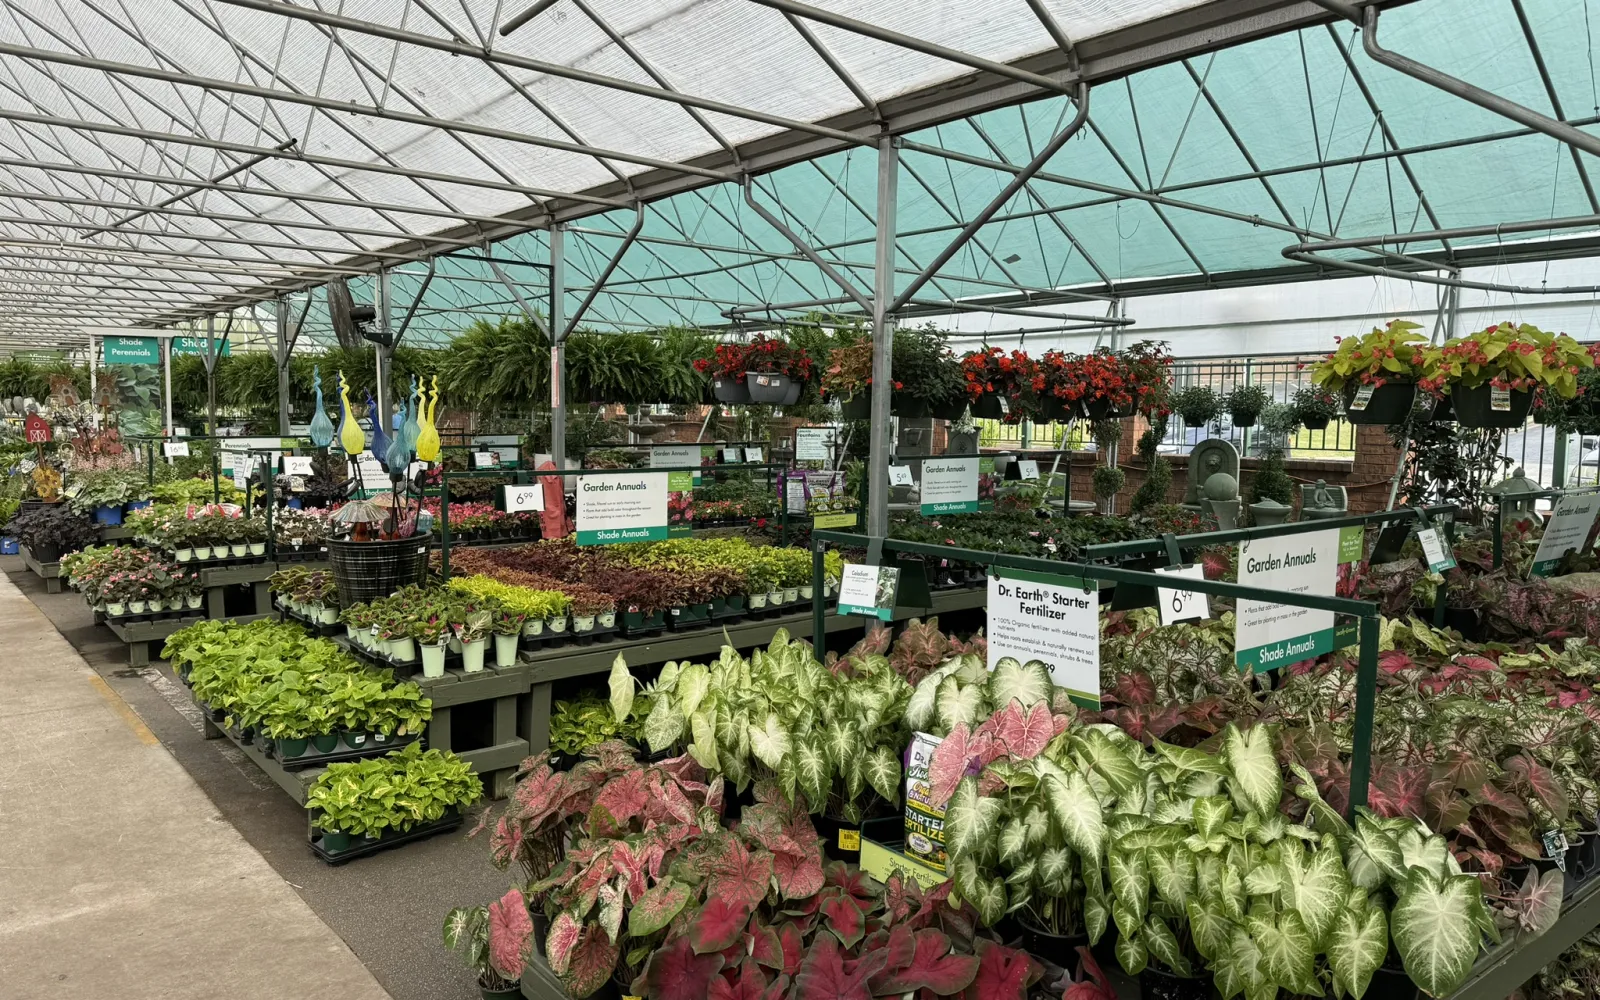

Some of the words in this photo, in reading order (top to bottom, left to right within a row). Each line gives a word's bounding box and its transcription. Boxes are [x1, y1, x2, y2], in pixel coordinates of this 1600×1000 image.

[118, 338, 143, 346] Shade
[112, 348, 151, 357] Perennials
[926, 465, 945, 474] Garden
[584, 482, 614, 492] Garden
[616, 480, 647, 490] Annuals
[597, 531, 620, 540] Shade
[622, 528, 649, 538] Annuals
[1247, 553, 1281, 574] Garden
[1283, 547, 1316, 569] Annuals
[998, 584, 1012, 597] Dr.
[1052, 592, 1089, 609] Starter
[1020, 602, 1066, 620] Fertilizer
[1012, 620, 1030, 629] Organic
[1031, 623, 1050, 632] fertilizer
[1022, 637, 1040, 645] establish
[1047, 641, 1067, 651] naturally
[1260, 644, 1284, 664] Shade
[1286, 635, 1315, 656] Annuals
[1014, 644, 1032, 653] annuals,
[1033, 647, 1059, 658] perennials,
[1060, 652, 1075, 661] shrubs
[905, 816, 946, 842] ERTILIZE
[912, 868, 938, 886] Fertilize
